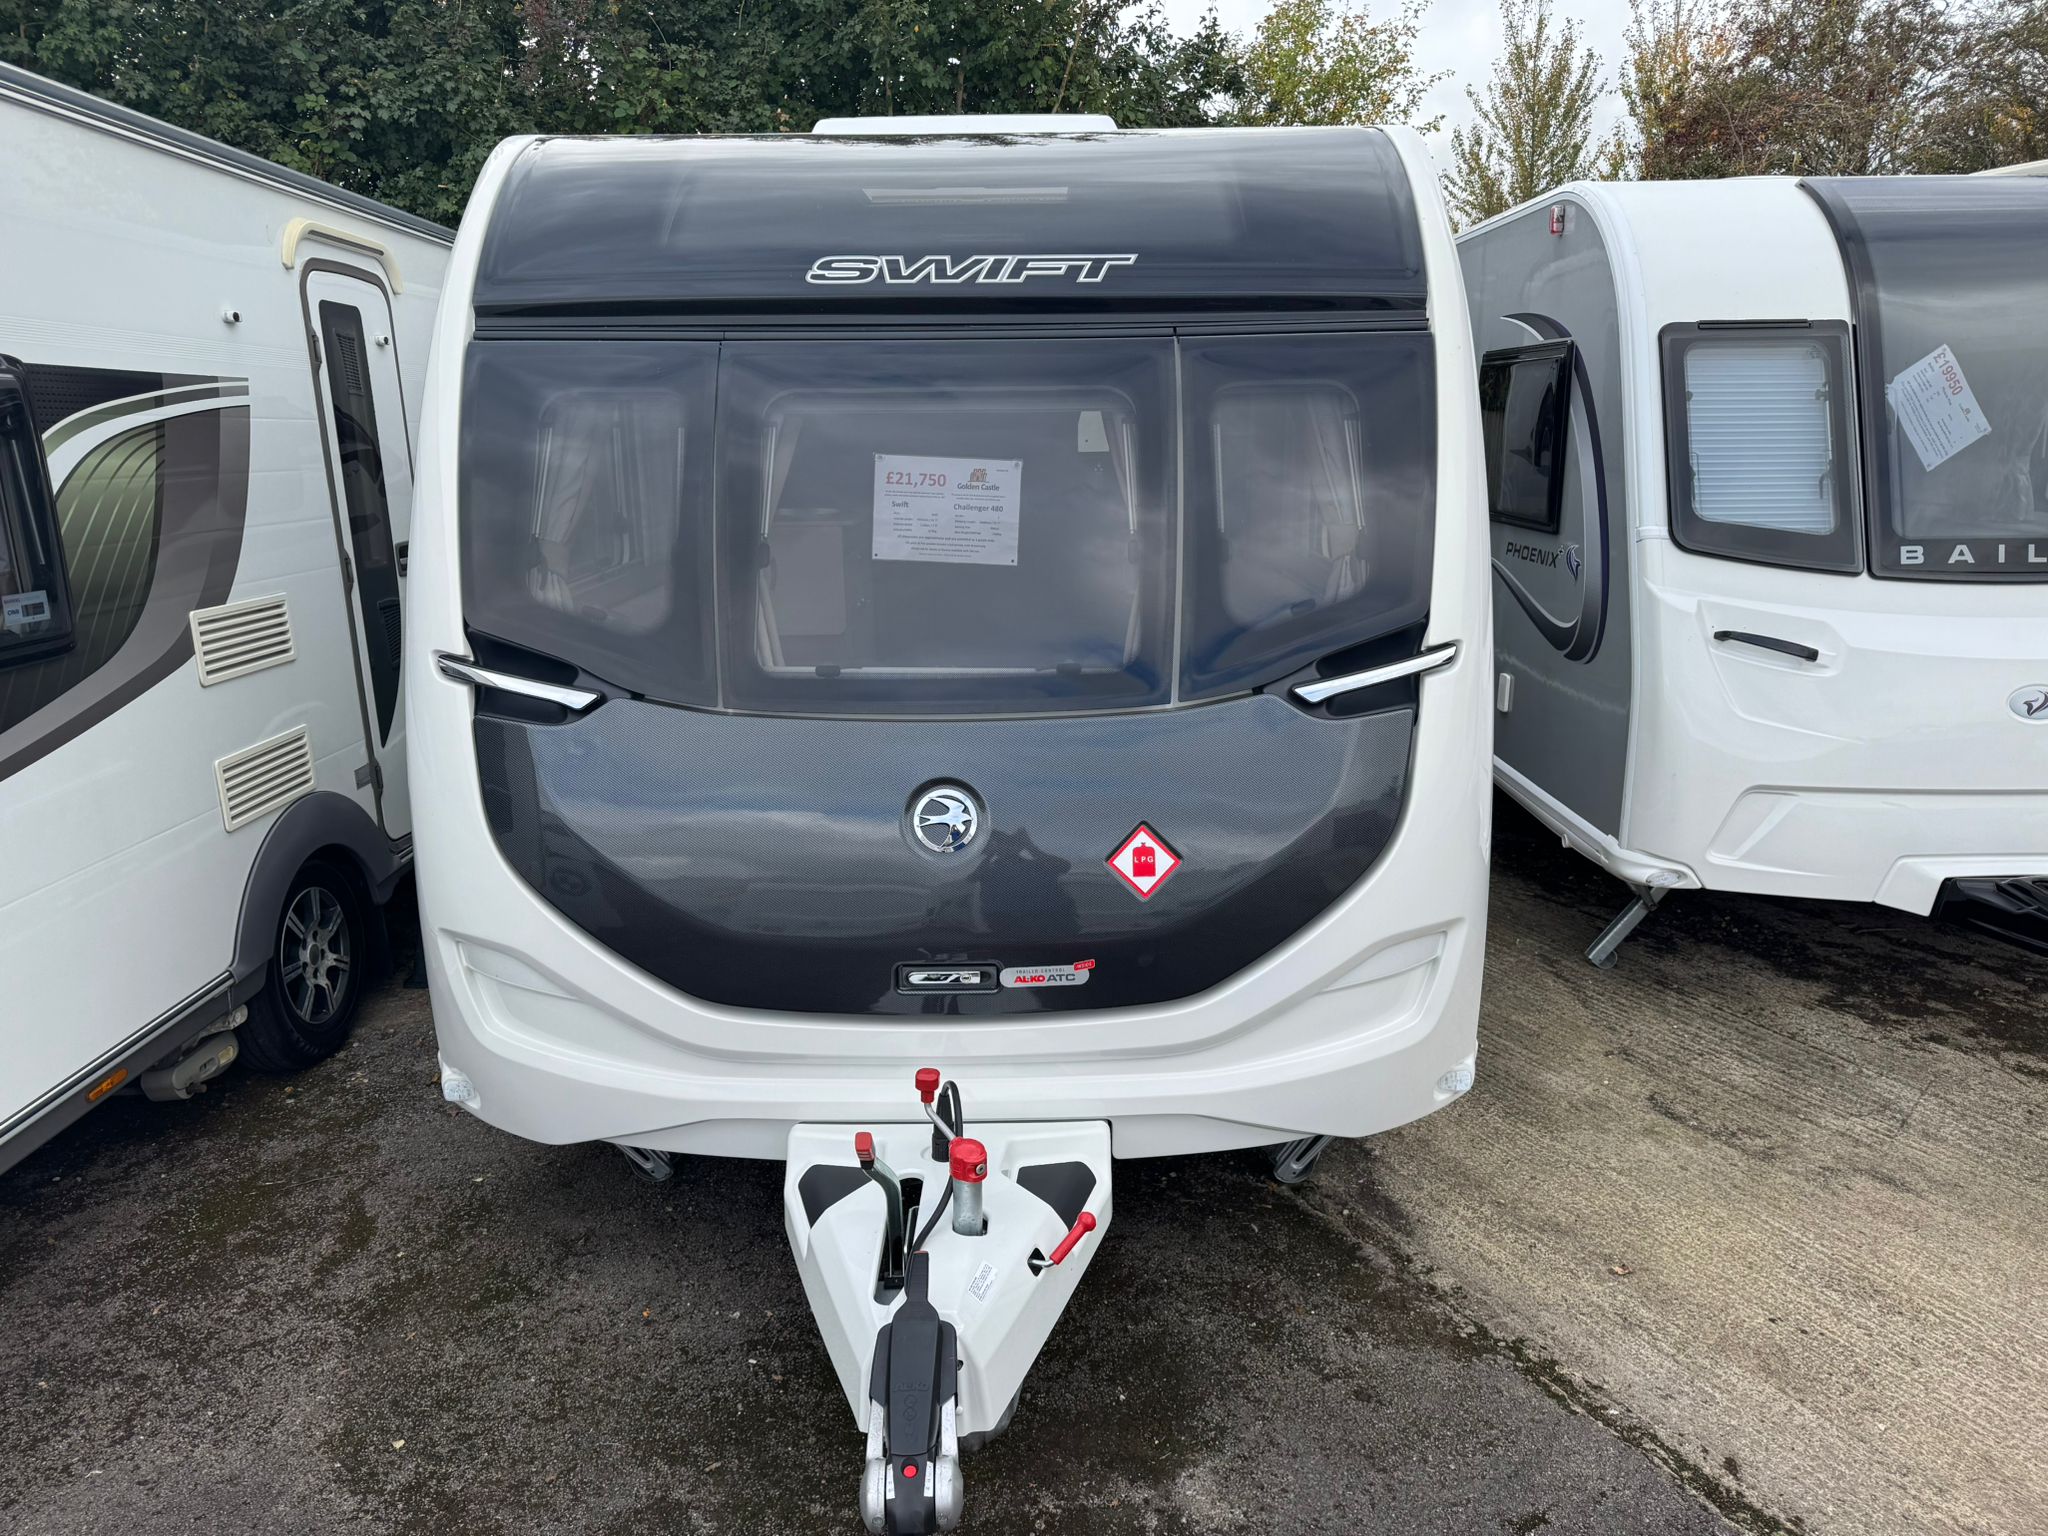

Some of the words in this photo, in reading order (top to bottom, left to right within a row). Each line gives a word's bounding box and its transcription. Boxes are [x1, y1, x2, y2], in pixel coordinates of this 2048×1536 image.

[805, 253, 1139, 284] SWIFT
[1933, 352, 1963, 396] £19950
[885, 471, 947, 488] £21,750
[957, 482, 980, 491] Golden
[980, 484, 1000, 492] Castle
[891, 500, 909, 508] Swift
[953, 503, 990, 513] Challenger
[1046, 973, 1076, 982] ATC
